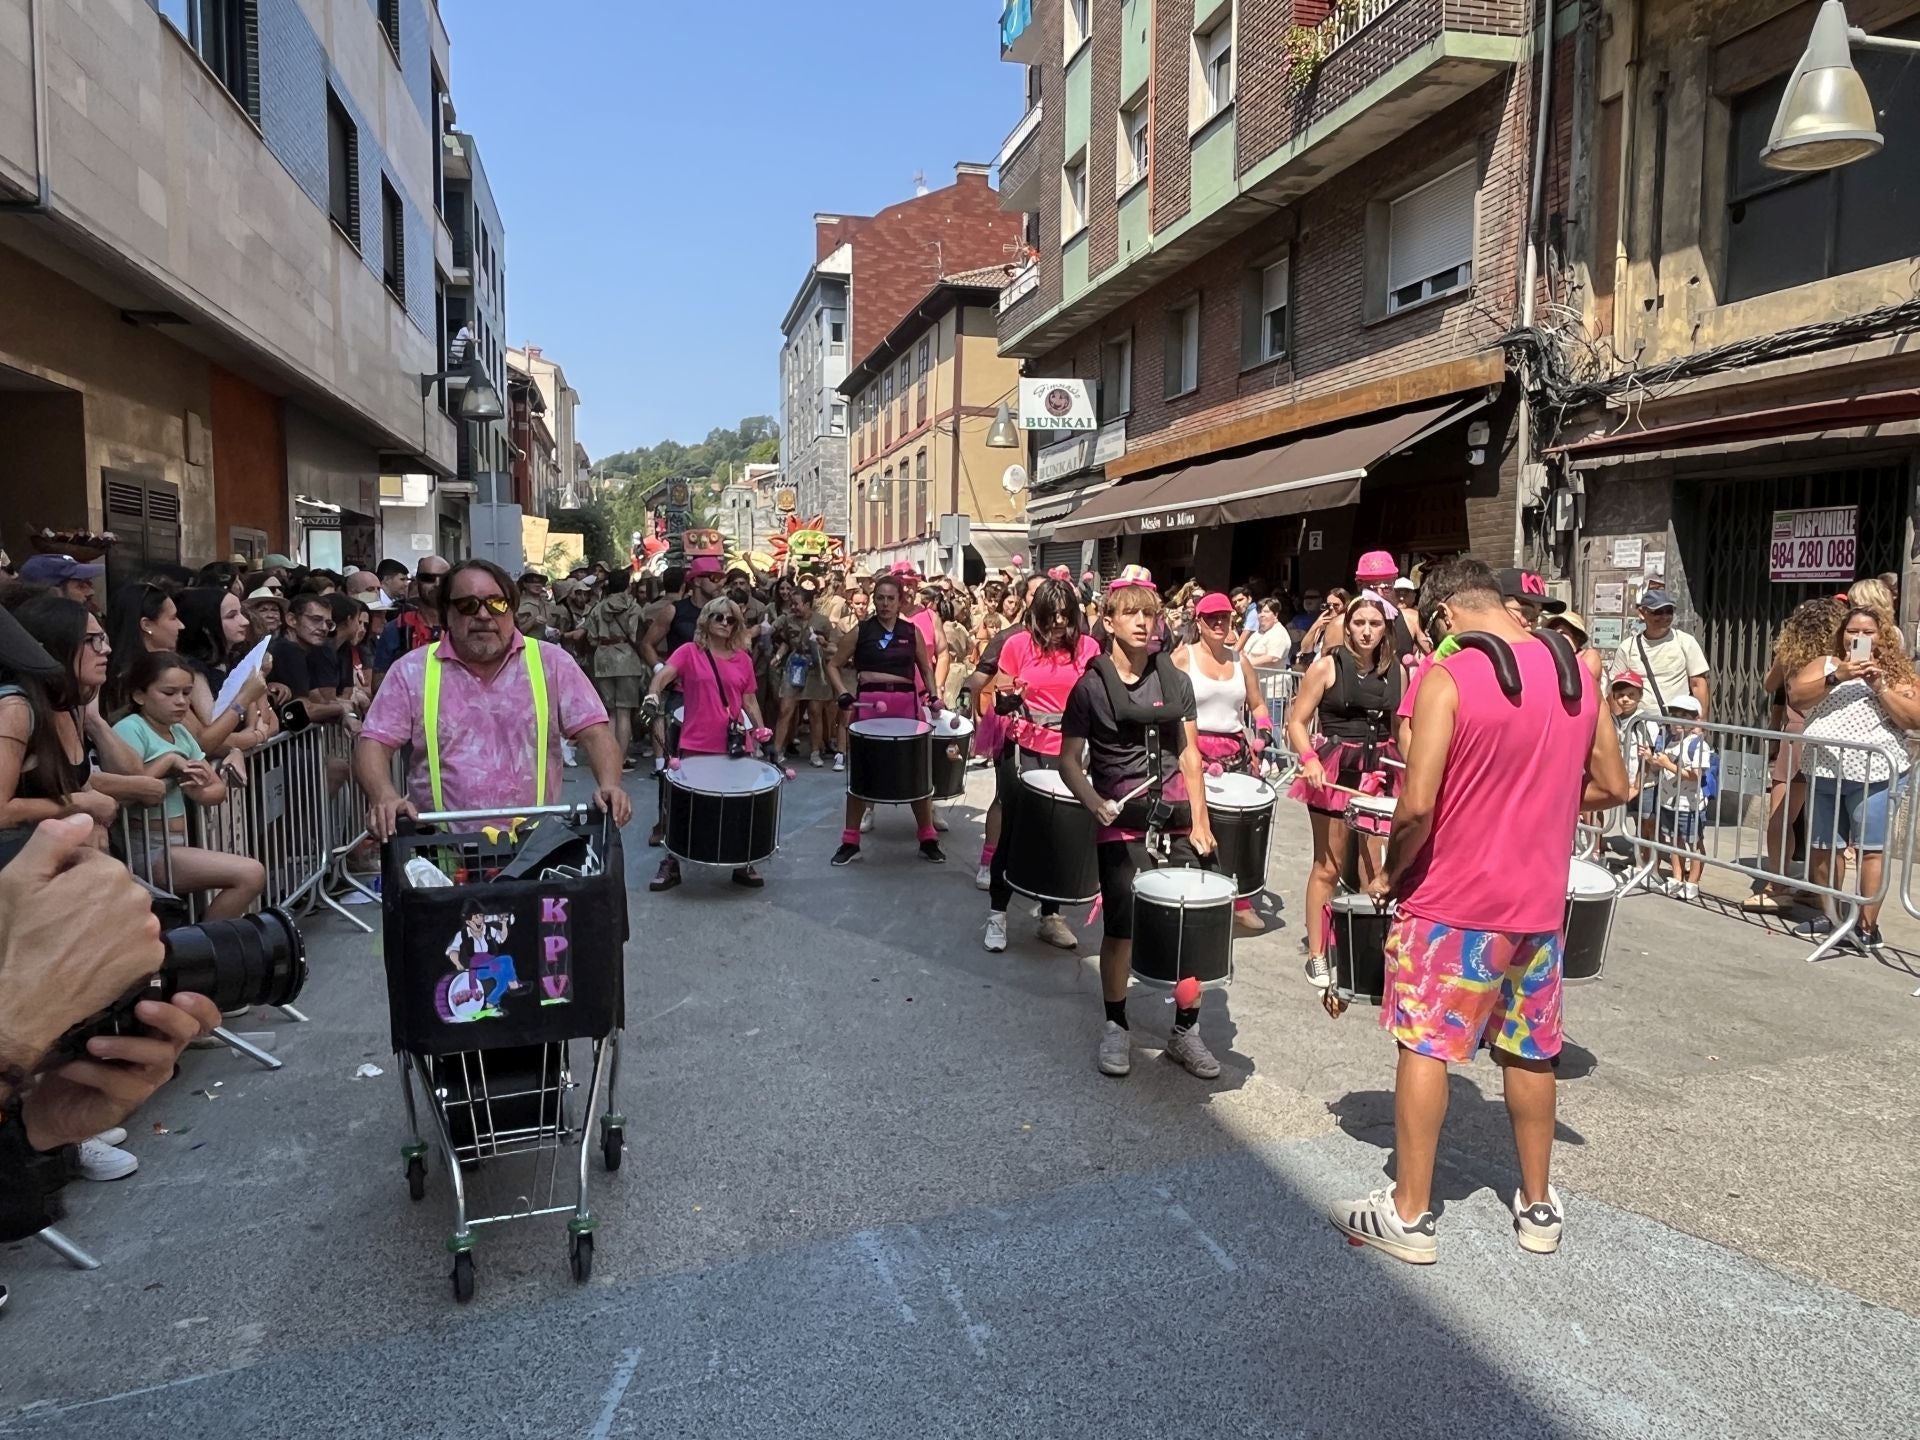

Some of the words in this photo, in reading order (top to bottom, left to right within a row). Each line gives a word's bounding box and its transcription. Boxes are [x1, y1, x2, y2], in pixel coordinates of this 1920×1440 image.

[1026, 417, 1093, 428] BUNKAI
[1039, 456, 1078, 480] BUNKAI
[299, 517, 341, 525] ONZALEZ
[1166, 514, 1175, 527] La
[1177, 512, 1195, 526] Mina
[1795, 510, 1857, 537] DISPONIBLE
[1313, 537, 1319, 547] 2
[1772, 542, 1795, 569] 984
[1798, 540, 1824, 568] 280
[1828, 538, 1855, 568] 088
